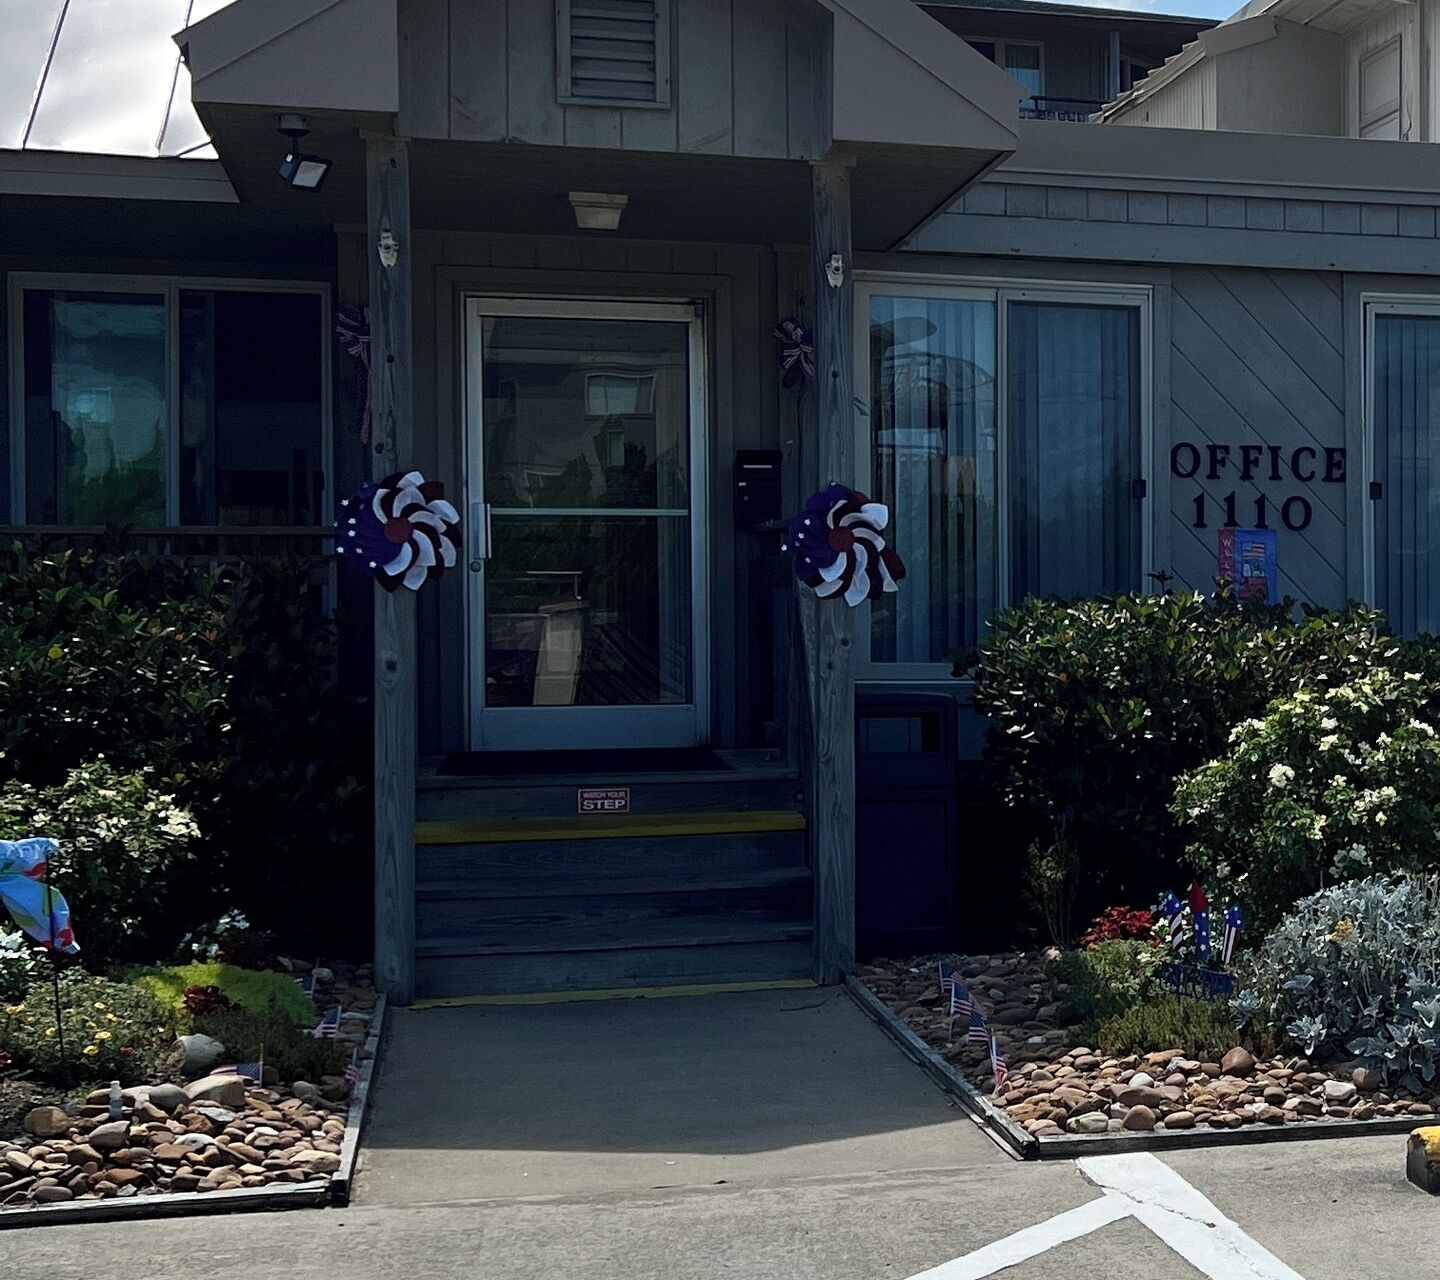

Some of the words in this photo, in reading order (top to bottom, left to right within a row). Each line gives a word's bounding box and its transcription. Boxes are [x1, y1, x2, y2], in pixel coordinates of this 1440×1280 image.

[1170, 442, 1346, 482] OFFICE
[1193, 491, 1312, 532] 1110
[582, 800, 626, 810] STEP
